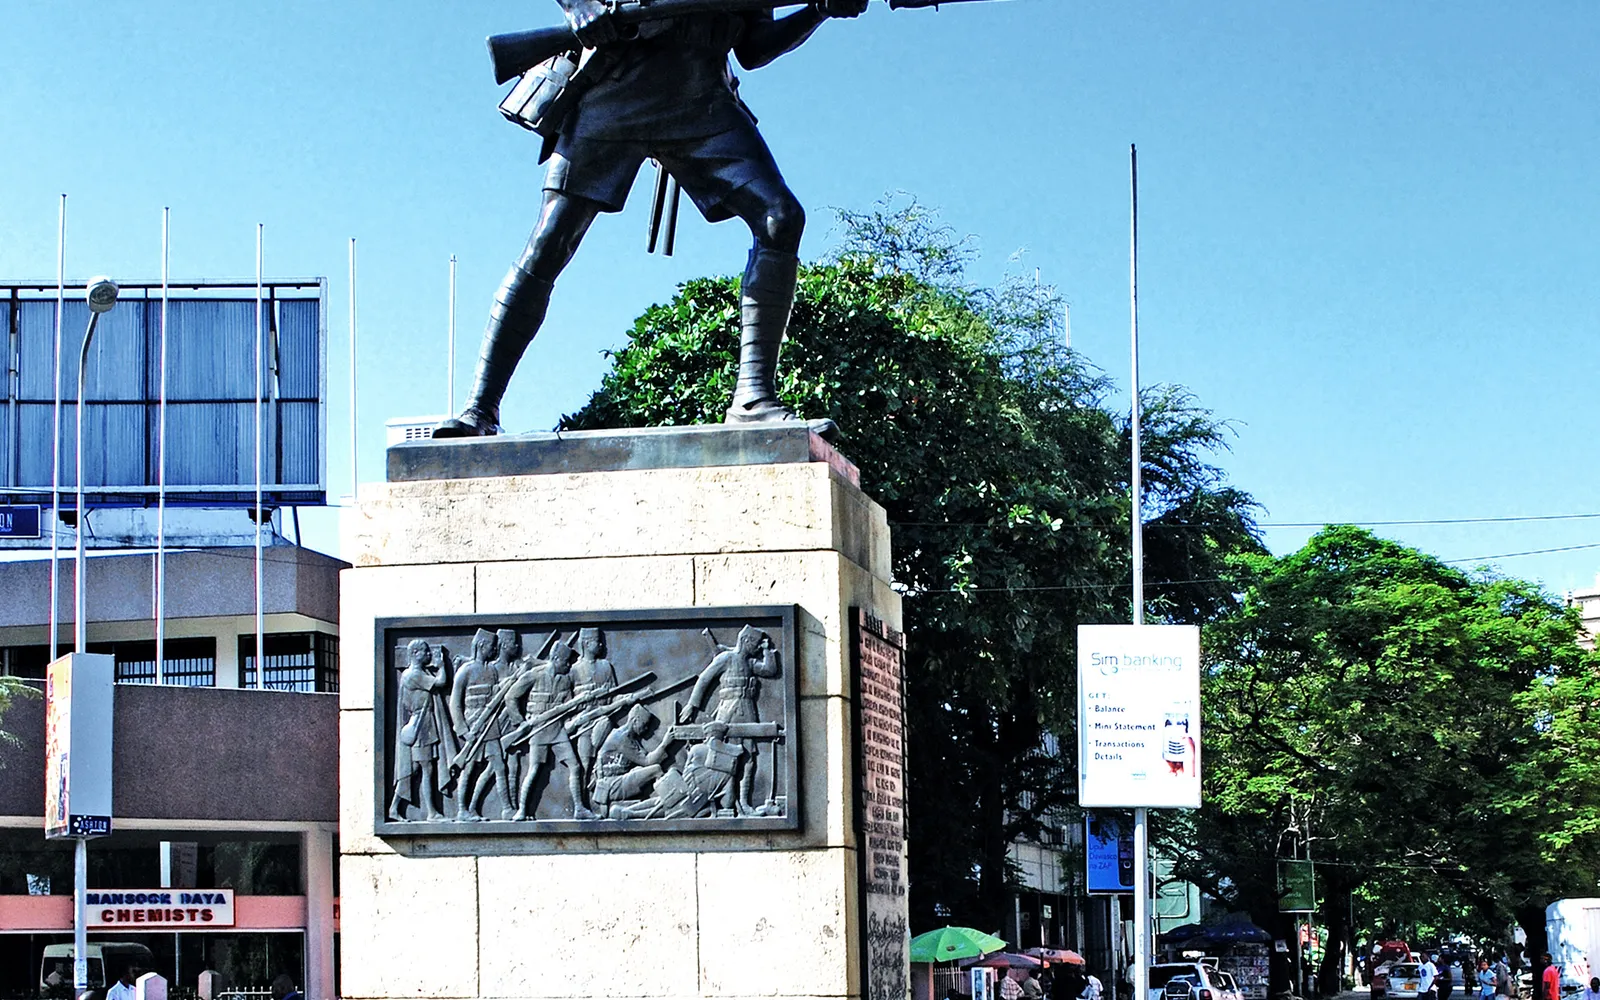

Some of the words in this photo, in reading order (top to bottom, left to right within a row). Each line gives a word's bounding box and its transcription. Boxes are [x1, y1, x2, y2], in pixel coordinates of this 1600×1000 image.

[1091, 652, 1118, 666] Sim
[1123, 653, 1182, 671] banking
[1094, 704, 1126, 713] Balance
[1094, 722, 1112, 730] Mini
[1114, 722, 1156, 731] Statement
[1095, 739, 1145, 748] Transactions
[1094, 752, 1123, 760] Details
[180, 892, 226, 905] DAYA
[101, 908, 214, 922] CHEMISTS
